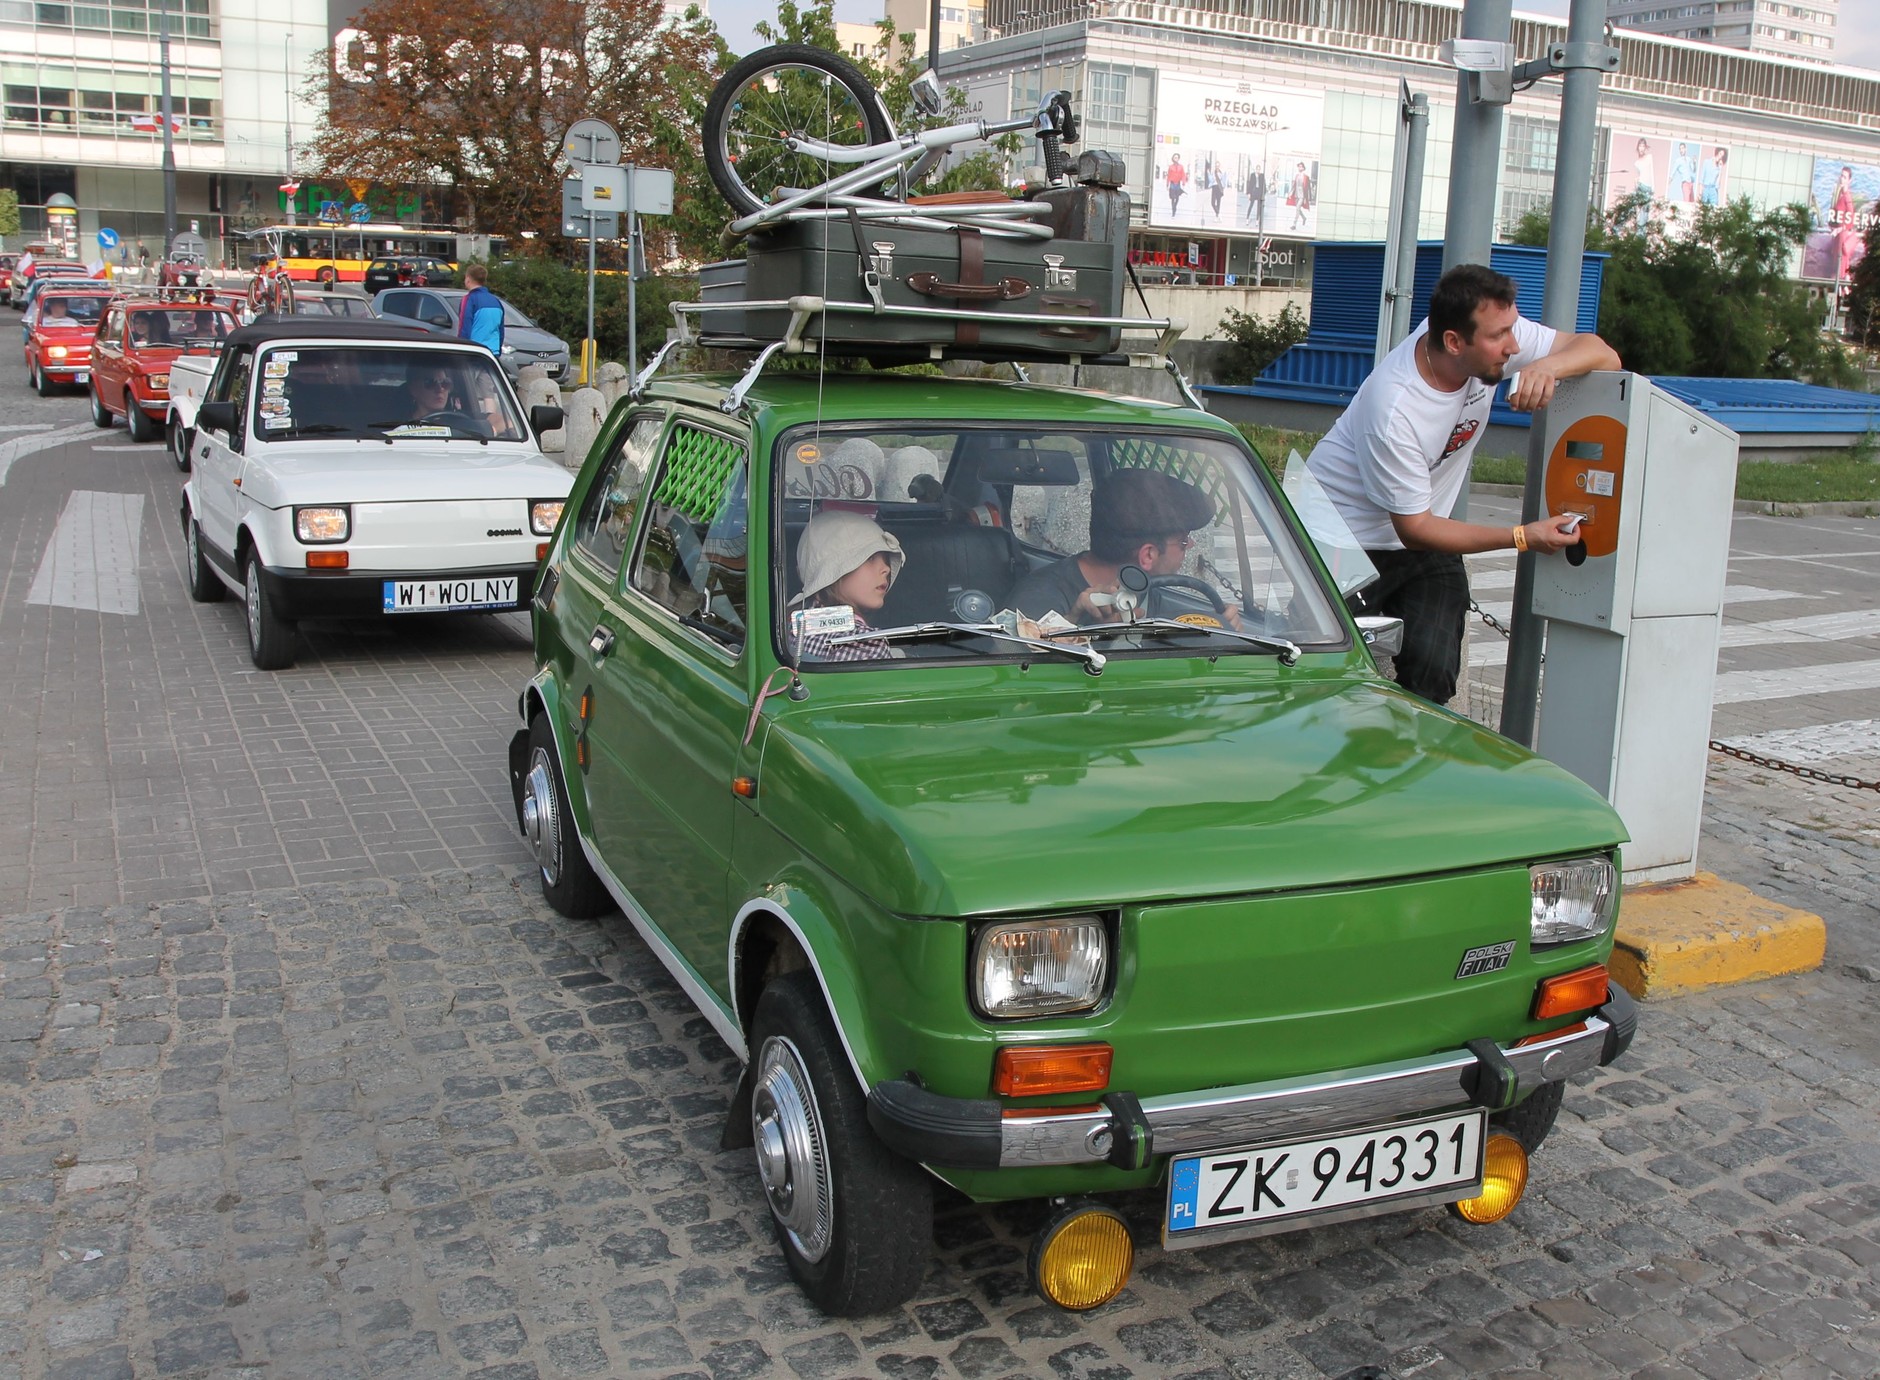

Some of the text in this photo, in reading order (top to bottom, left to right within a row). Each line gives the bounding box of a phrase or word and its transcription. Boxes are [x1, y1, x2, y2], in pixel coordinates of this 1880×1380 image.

[1204, 114, 1279, 131] WARSZAWSKI
[1828, 209, 1880, 227] RESERV
[1618, 378, 1627, 402] 1
[384, 597, 394, 605] PL
[400, 579, 514, 606] W1 WOLNY
[819, 617, 846, 628] ZK 94331
[1466, 942, 1514, 961] POLSKI
[1461, 953, 1509, 976] FIAT
[1207, 1122, 1465, 1219] ZK 94331
[1172, 1202, 1194, 1219] PL
